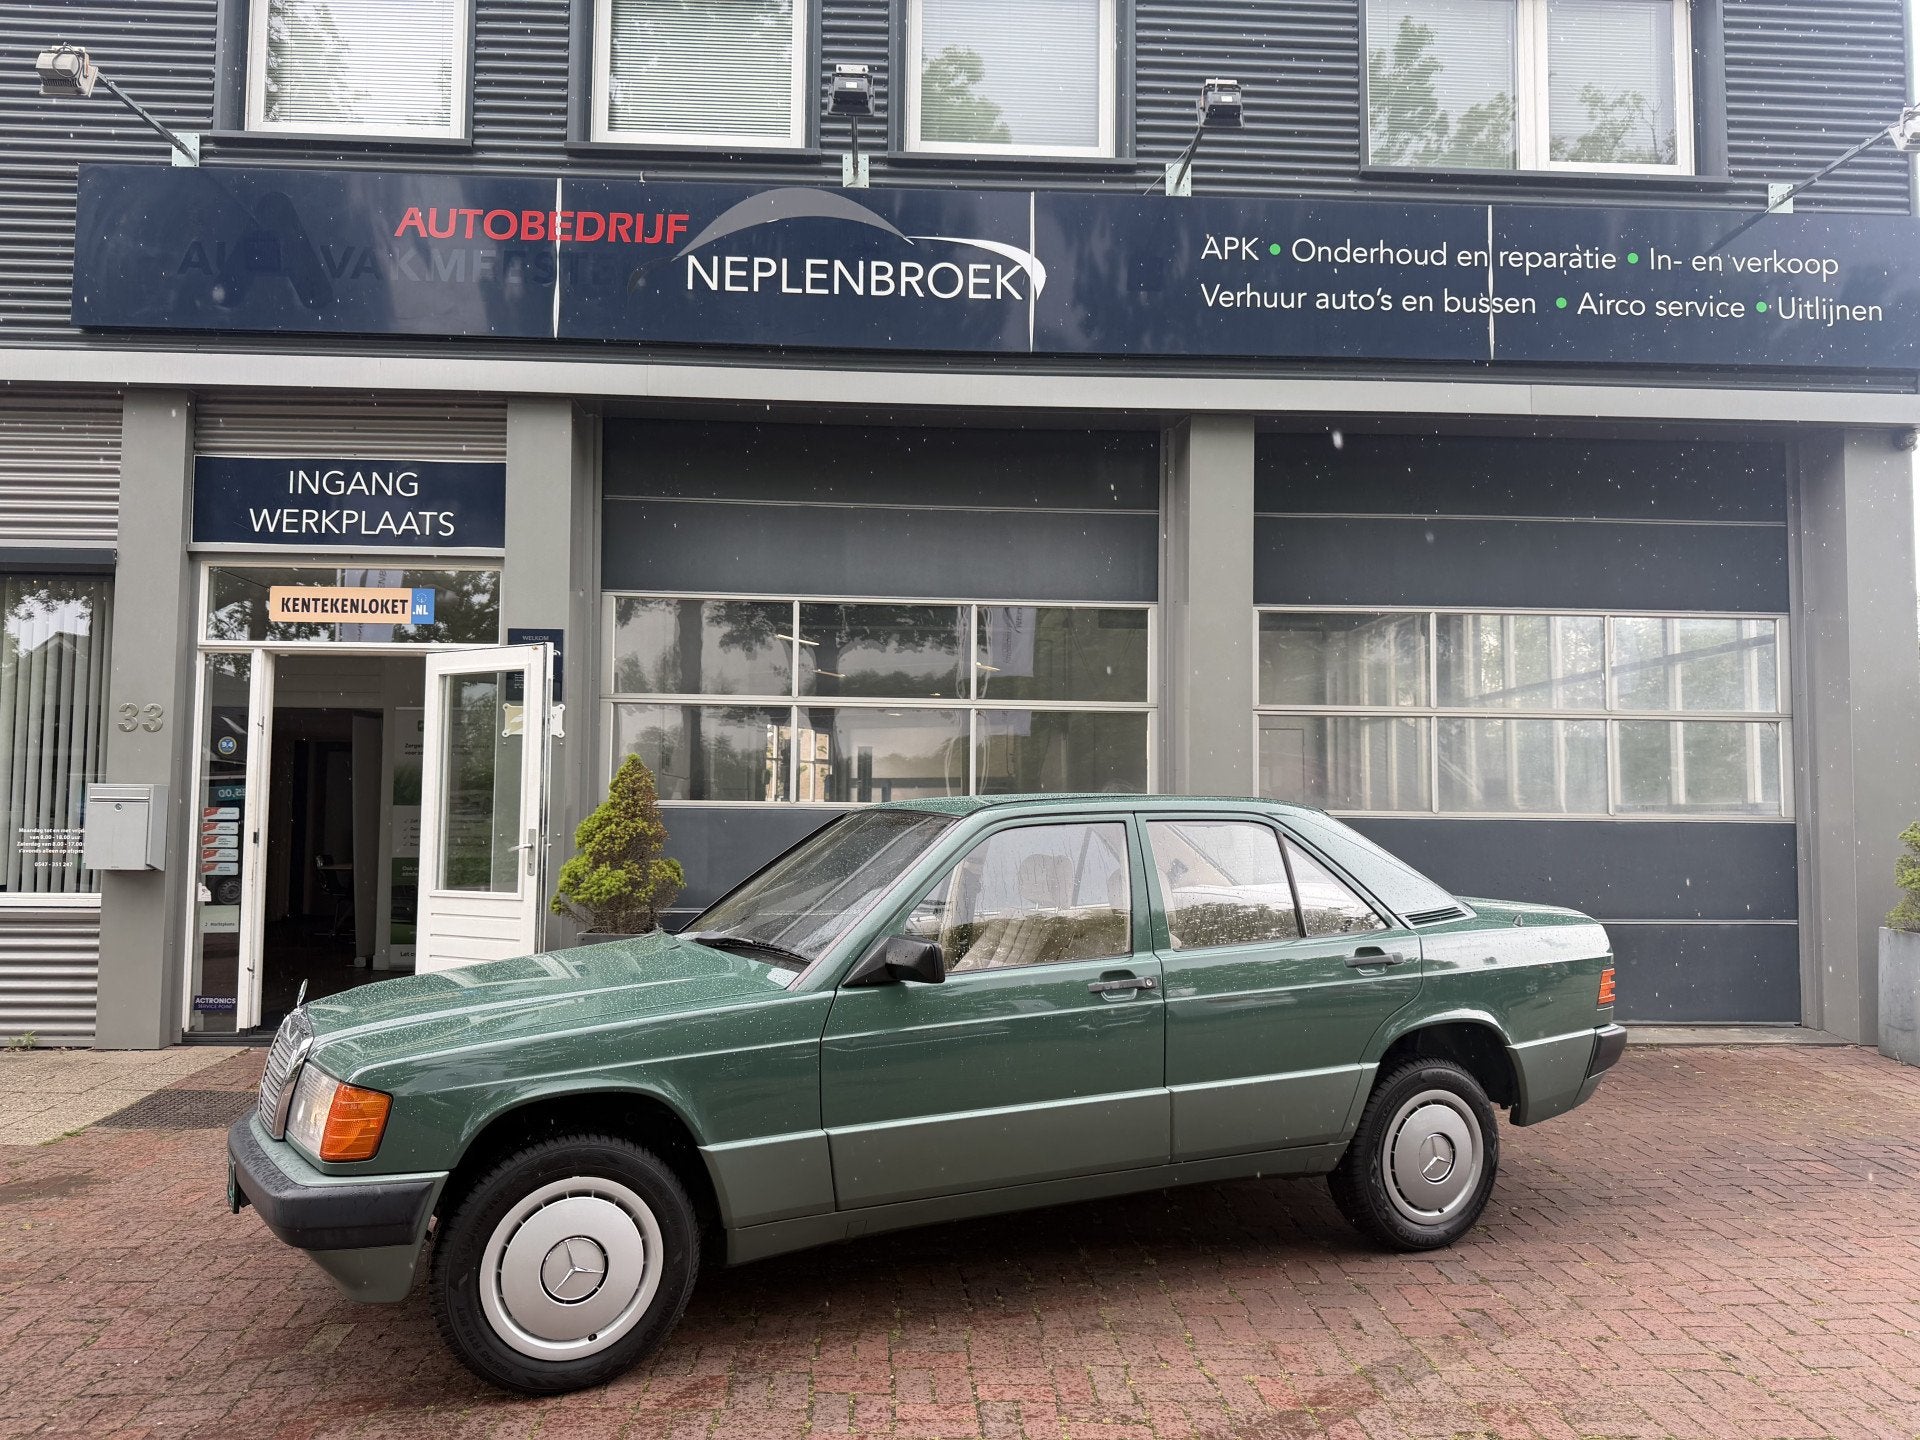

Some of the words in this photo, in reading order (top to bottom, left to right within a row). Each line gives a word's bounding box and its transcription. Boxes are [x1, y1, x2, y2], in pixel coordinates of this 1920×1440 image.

[394, 206, 690, 245] AUTOBEDRIJF
[1200, 235, 1260, 261] APK
[1291, 237, 1447, 266] Onderhoud
[1457, 249, 1489, 267] en
[1499, 246, 1617, 276] reparatie
[1649, 247, 1683, 271] In-
[1691, 254, 1723, 273] en
[1733, 249, 1839, 283] verkoop
[686, 255, 1024, 301] NEPLENBROEK
[1201, 282, 1307, 309] Verhuur
[1315, 287, 1393, 311] auto's
[1401, 295, 1433, 312] en
[1444, 288, 1536, 315] bussen
[1577, 291, 1646, 318] Airco
[1655, 296, 1746, 319] service
[1777, 296, 1884, 327] Uitlijnen
[288, 470, 420, 497] INGANG
[249, 507, 456, 538] WERKPLAATS
[281, 596, 409, 615] KENTEKENLOKET
[117, 702, 164, 733] 33
